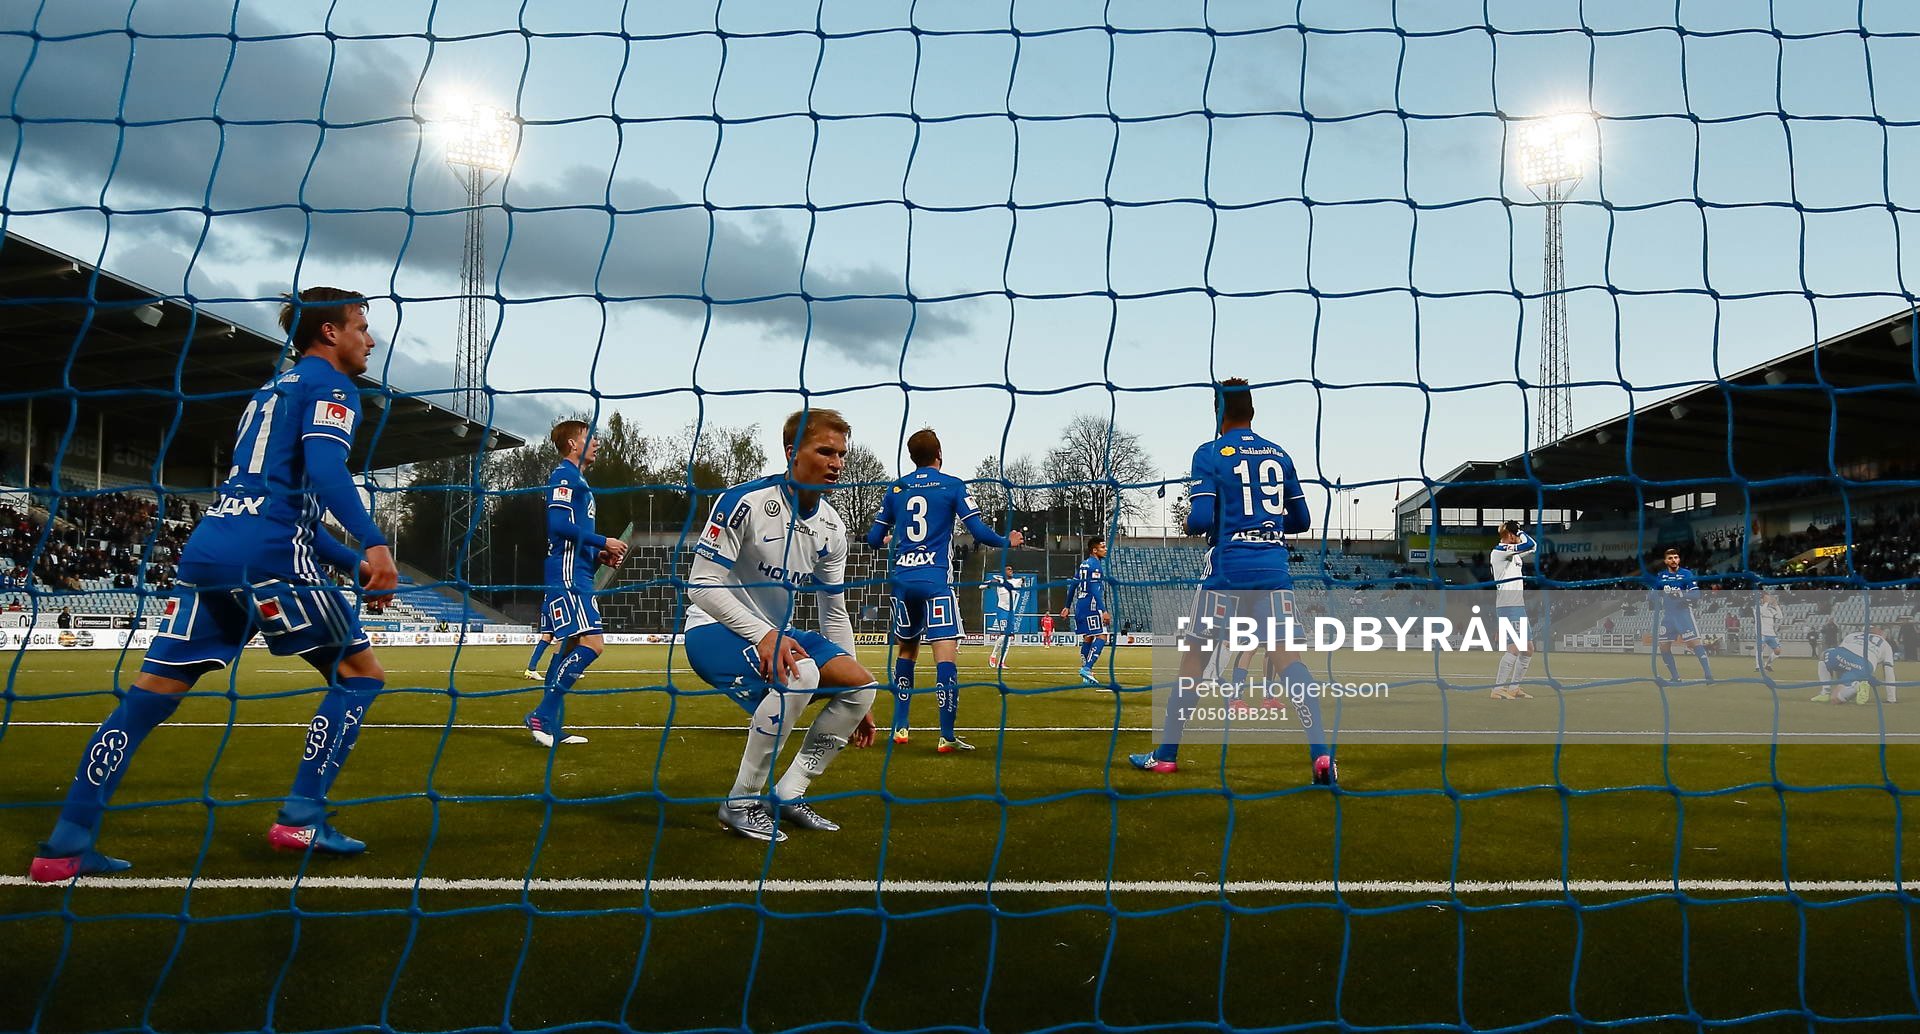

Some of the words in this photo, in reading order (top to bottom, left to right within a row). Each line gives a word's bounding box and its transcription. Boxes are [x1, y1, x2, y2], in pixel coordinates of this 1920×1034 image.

[1233, 459, 1285, 515] 19
[906, 496, 928, 542] 3
[896, 551, 937, 567] ABAX
